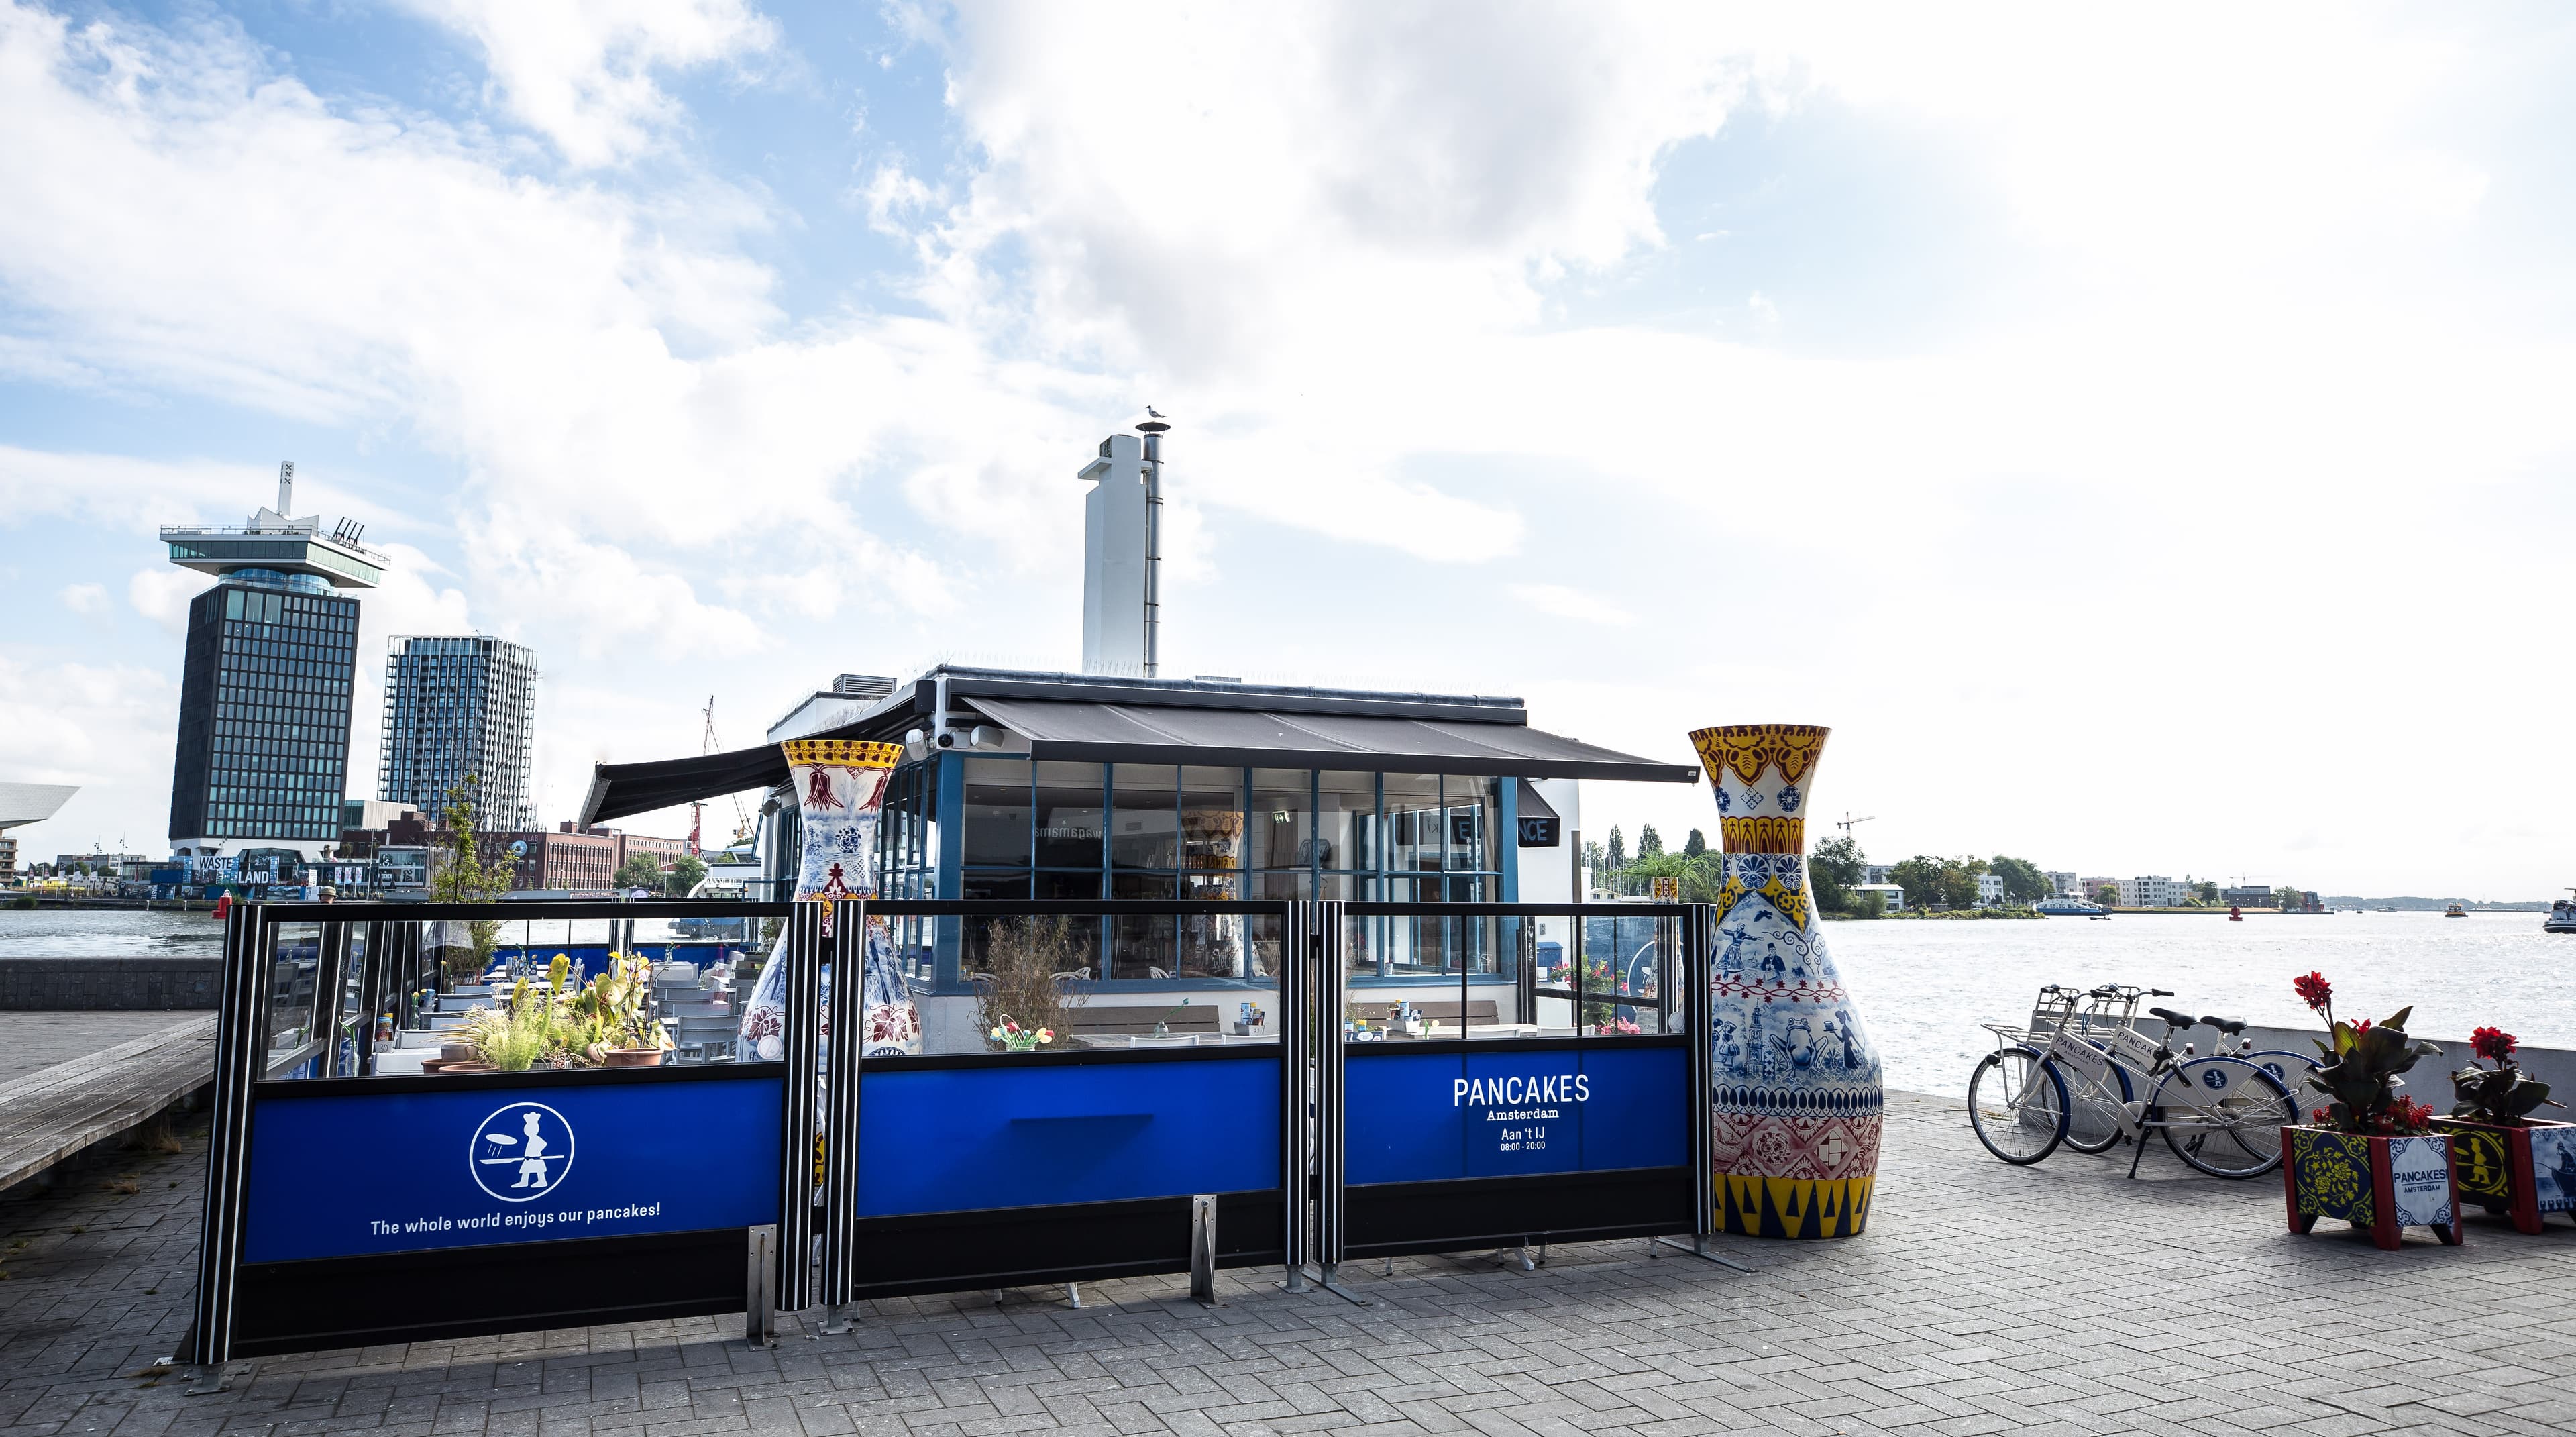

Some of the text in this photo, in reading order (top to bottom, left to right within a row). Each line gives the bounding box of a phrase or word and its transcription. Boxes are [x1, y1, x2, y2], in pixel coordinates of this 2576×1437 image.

[200, 857, 232, 869] WASTE
[238, 871, 269, 884] LAND
[380, 1044, 388, 1052] 30
[2118, 1031, 2155, 1055] PANCAK
[2055, 1036, 2105, 1067] PANCAKES
[1454, 1074, 1589, 1106] PANCAKES
[1486, 1108, 1559, 1121] Amsterdam
[1501, 1128, 1521, 1140] Aan
[1536, 1126, 1545, 1139] IJ
[1500, 1142, 1520, 1151] 08:00
[1526, 1141, 1546, 1150] 20:00
[2394, 1169, 2446, 1183] PANCAKES
[2404, 1184, 2440, 1193] AMSTERDAM
[370, 1202, 661, 1235] The whole world enjoys our pancakes!
